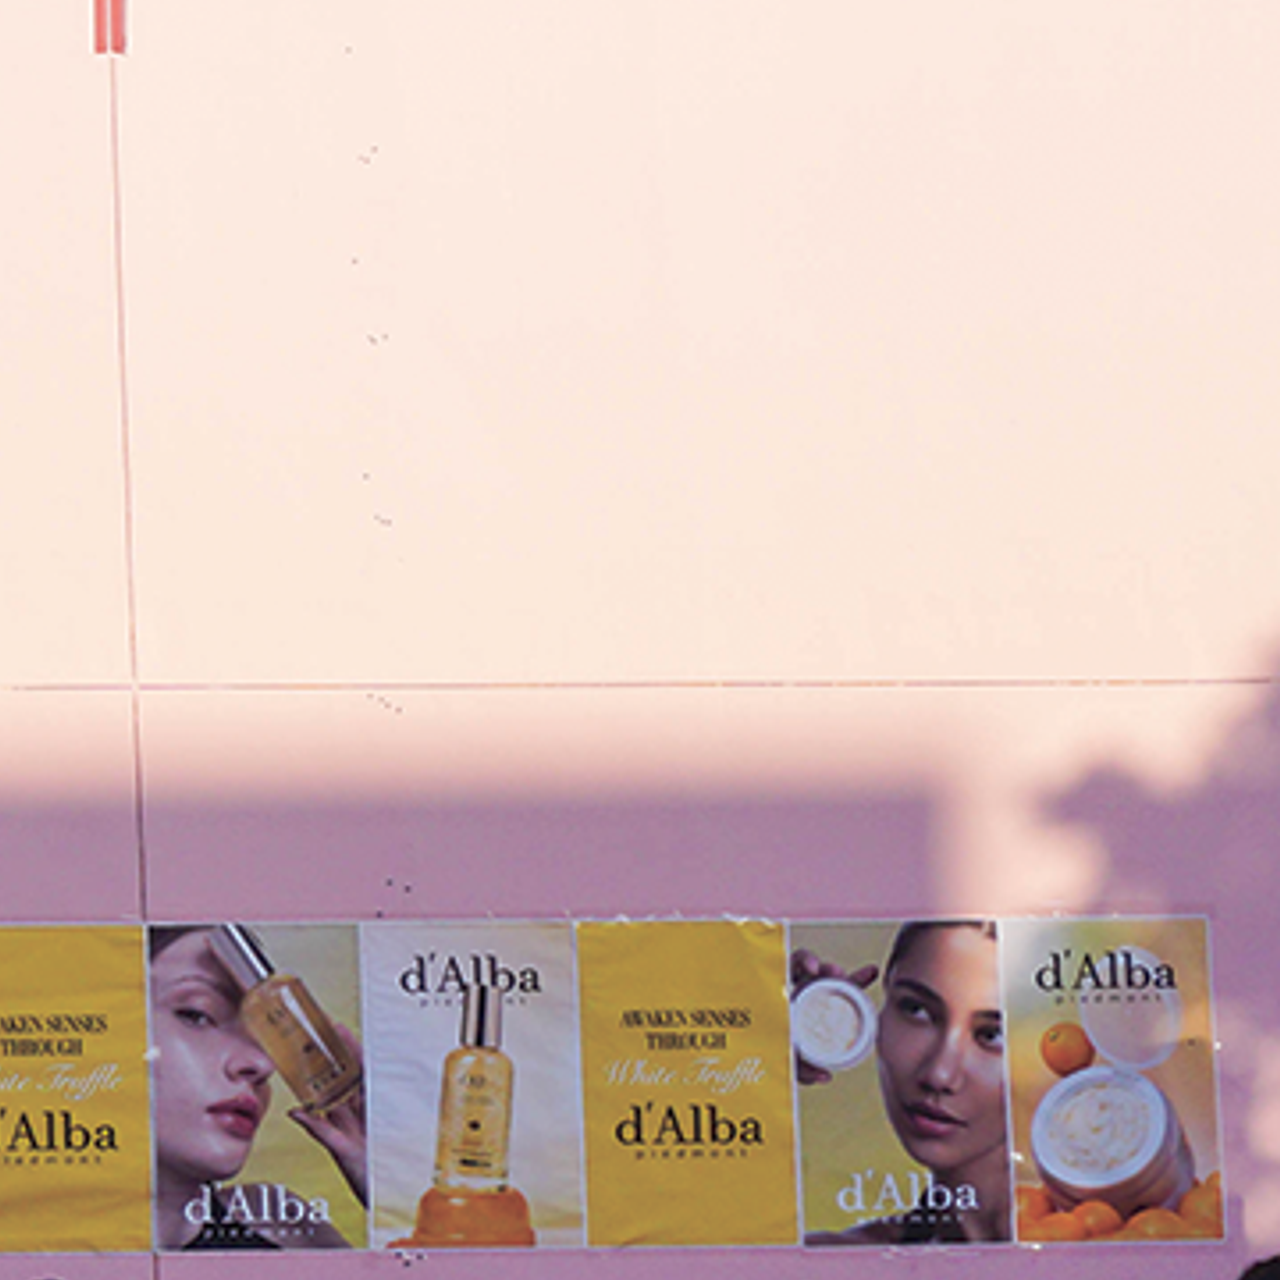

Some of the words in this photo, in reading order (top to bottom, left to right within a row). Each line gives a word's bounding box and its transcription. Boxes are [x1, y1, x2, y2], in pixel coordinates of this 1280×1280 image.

[399, 952, 542, 994] d'Alba
[1035, 950, 1177, 990] d'Alba
[0, 1039, 84, 1057] THROUGH
[646, 1034, 727, 1051] THROUGH
[614, 1102, 764, 1147] d'Alba
[183, 1183, 330, 1224] d'Alba
[836, 1168, 980, 1212] d'Alba
